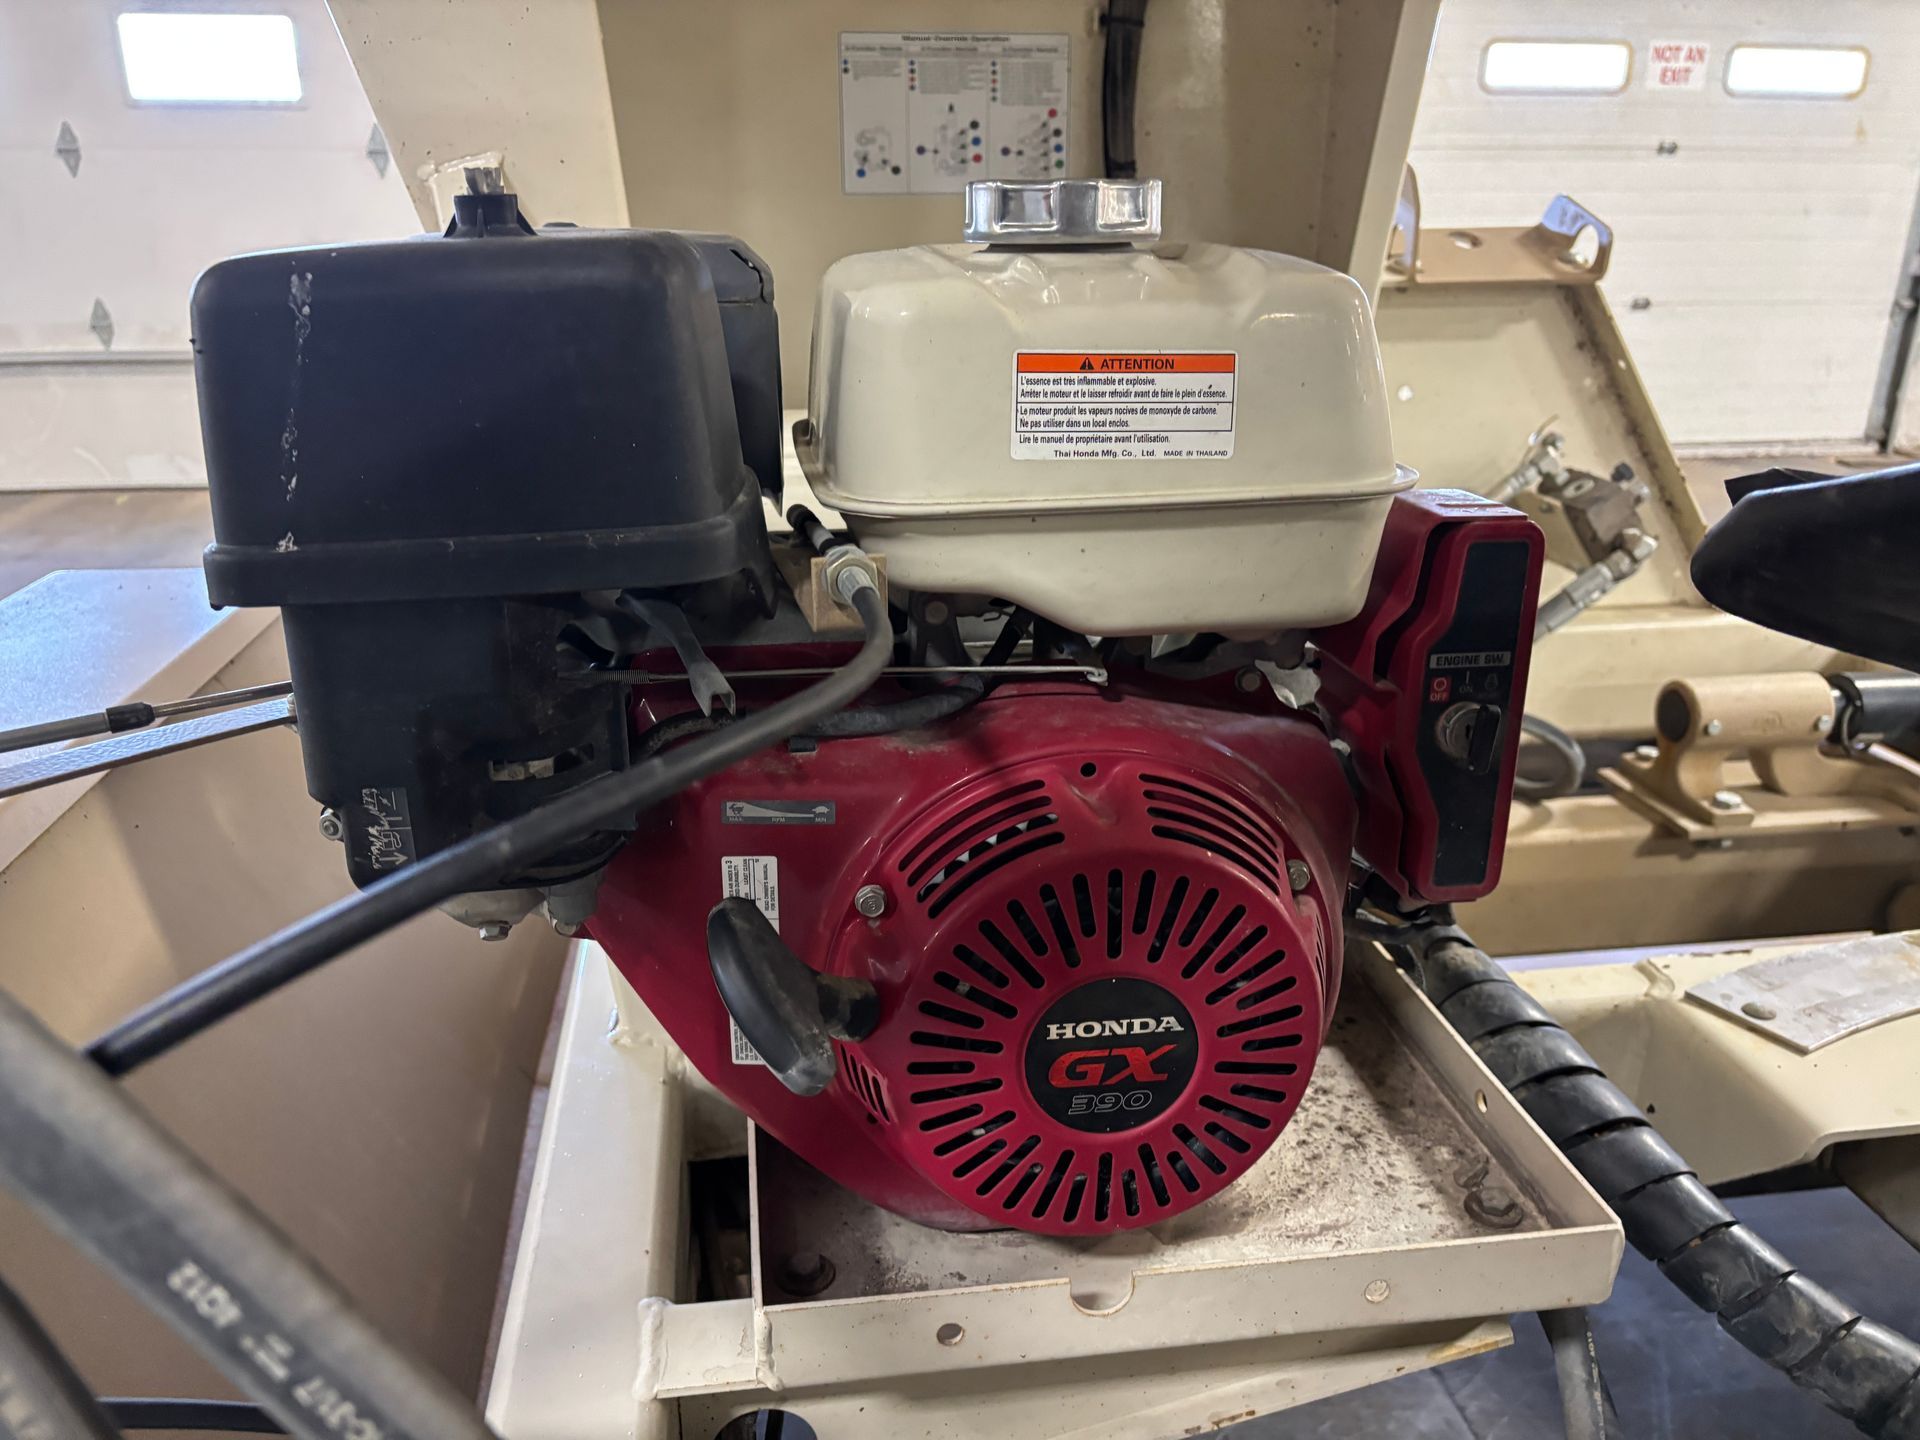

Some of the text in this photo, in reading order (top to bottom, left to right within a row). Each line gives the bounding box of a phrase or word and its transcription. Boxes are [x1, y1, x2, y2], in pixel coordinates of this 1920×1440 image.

[1652, 45, 1706, 63] NOT AN
[1659, 66, 1692, 85] EXIT
[1100, 358, 1175, 370] ATTENTION
[1020, 376, 1157, 388] L'essence est très inflammable et explosive.
[1043, 388, 1049, 398] le
[1050, 389, 1072, 398] moteur
[1073, 389, 1079, 398] et
[1081, 388, 1086, 398] le
[1088, 388, 1107, 398] laisser
[1109, 388, 1132, 398] refroidir
[1134, 389, 1150, 398] avant
[1152, 389, 1159, 398] de
[1161, 388, 1173, 398] faire
[1175, 389, 1180, 398] le
[1182, 388, 1196, 400] plein
[1197, 389, 1228, 398] d'essence.
[1020, 406, 1028, 415] Le
[1029, 407, 1052, 415] moteur
[1053, 406, 1076, 417] produit
[1078, 406, 1087, 415] les
[1088, 407, 1113, 417] vapeurs
[1115, 406, 1138, 415] nocives
[1139, 406, 1147, 415] de
[1149, 406, 1181, 417] monoxyde
[1182, 406, 1191, 415] de
[1020, 418, 1029, 428] Ne
[1030, 420, 1041, 429] pas
[1042, 418, 1064, 428] utiliser
[1066, 418, 1080, 428] dans
[1082, 420, 1090, 428] un
[1092, 418, 1107, 428] local
[1020, 434, 1031, 443] Lire
[1033, 434, 1039, 443] le
[1040, 434, 1064, 443] manuel
[1066, 434, 1074, 443] de
[1075, 434, 1113, 445] propriétaire
[1114, 434, 1132, 443] avant
[1101, 450, 1120, 459] Mfg.
[1141, 449, 1157, 457] Ltd.
[1436, 655, 1481, 667] ENGINE
[1430, 692, 1448, 702] OFF
[1046, 1016, 1184, 1041] HONDA
[1048, 1044, 1177, 1088] GX
[1068, 1090, 1153, 1115] 390
